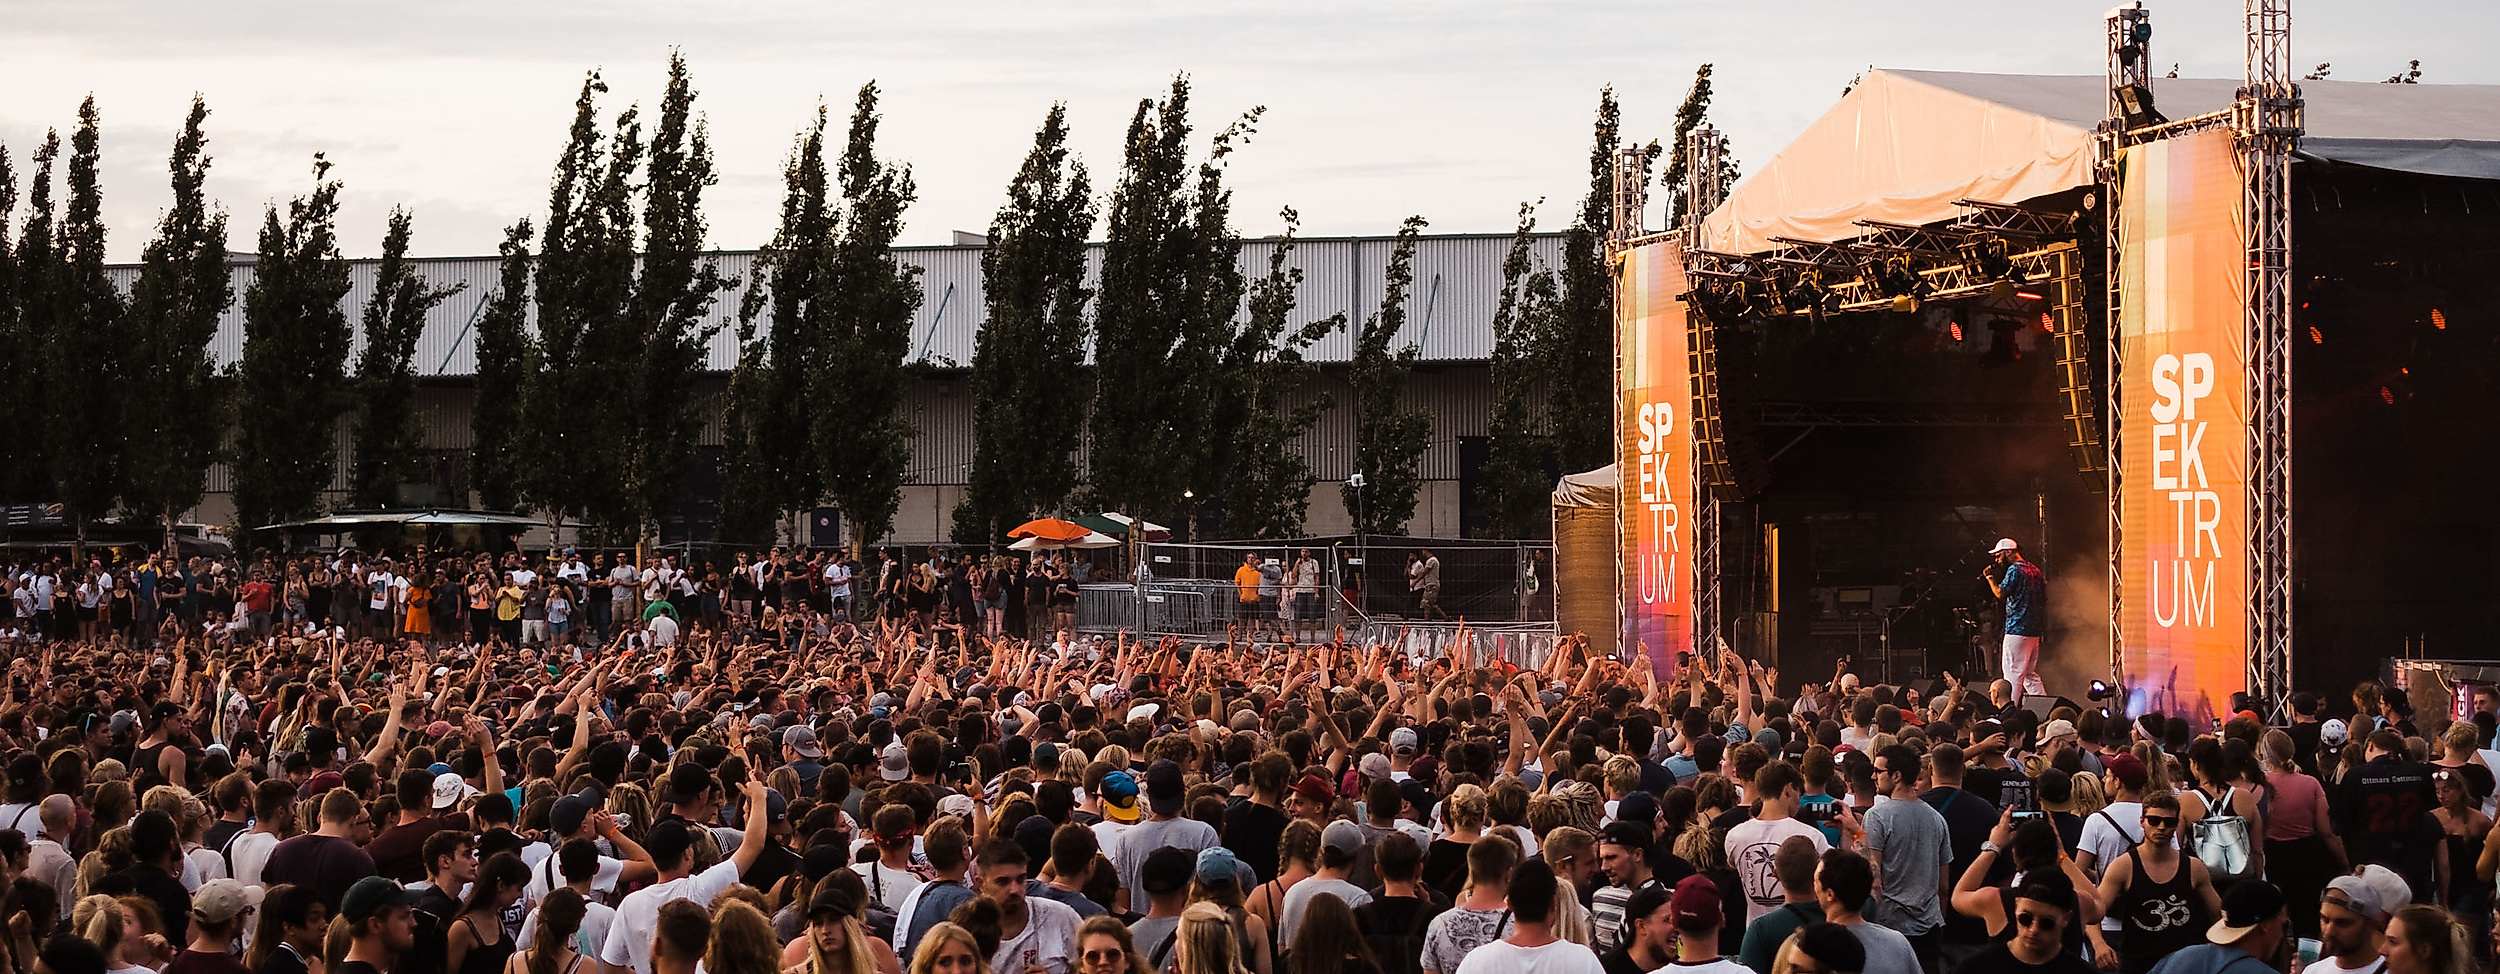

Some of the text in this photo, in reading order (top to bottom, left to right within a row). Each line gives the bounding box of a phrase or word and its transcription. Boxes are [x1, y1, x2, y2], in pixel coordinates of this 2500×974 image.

[2150, 352, 2214, 423] SP
[1638, 402, 1674, 454] SP
[2153, 421, 2209, 489] EK
[1640, 453, 1672, 503] EK
[1649, 503, 1679, 553] TR
[2169, 491, 2222, 558] TR
[1641, 554, 1676, 604] UM
[2153, 560, 2214, 628] UM
